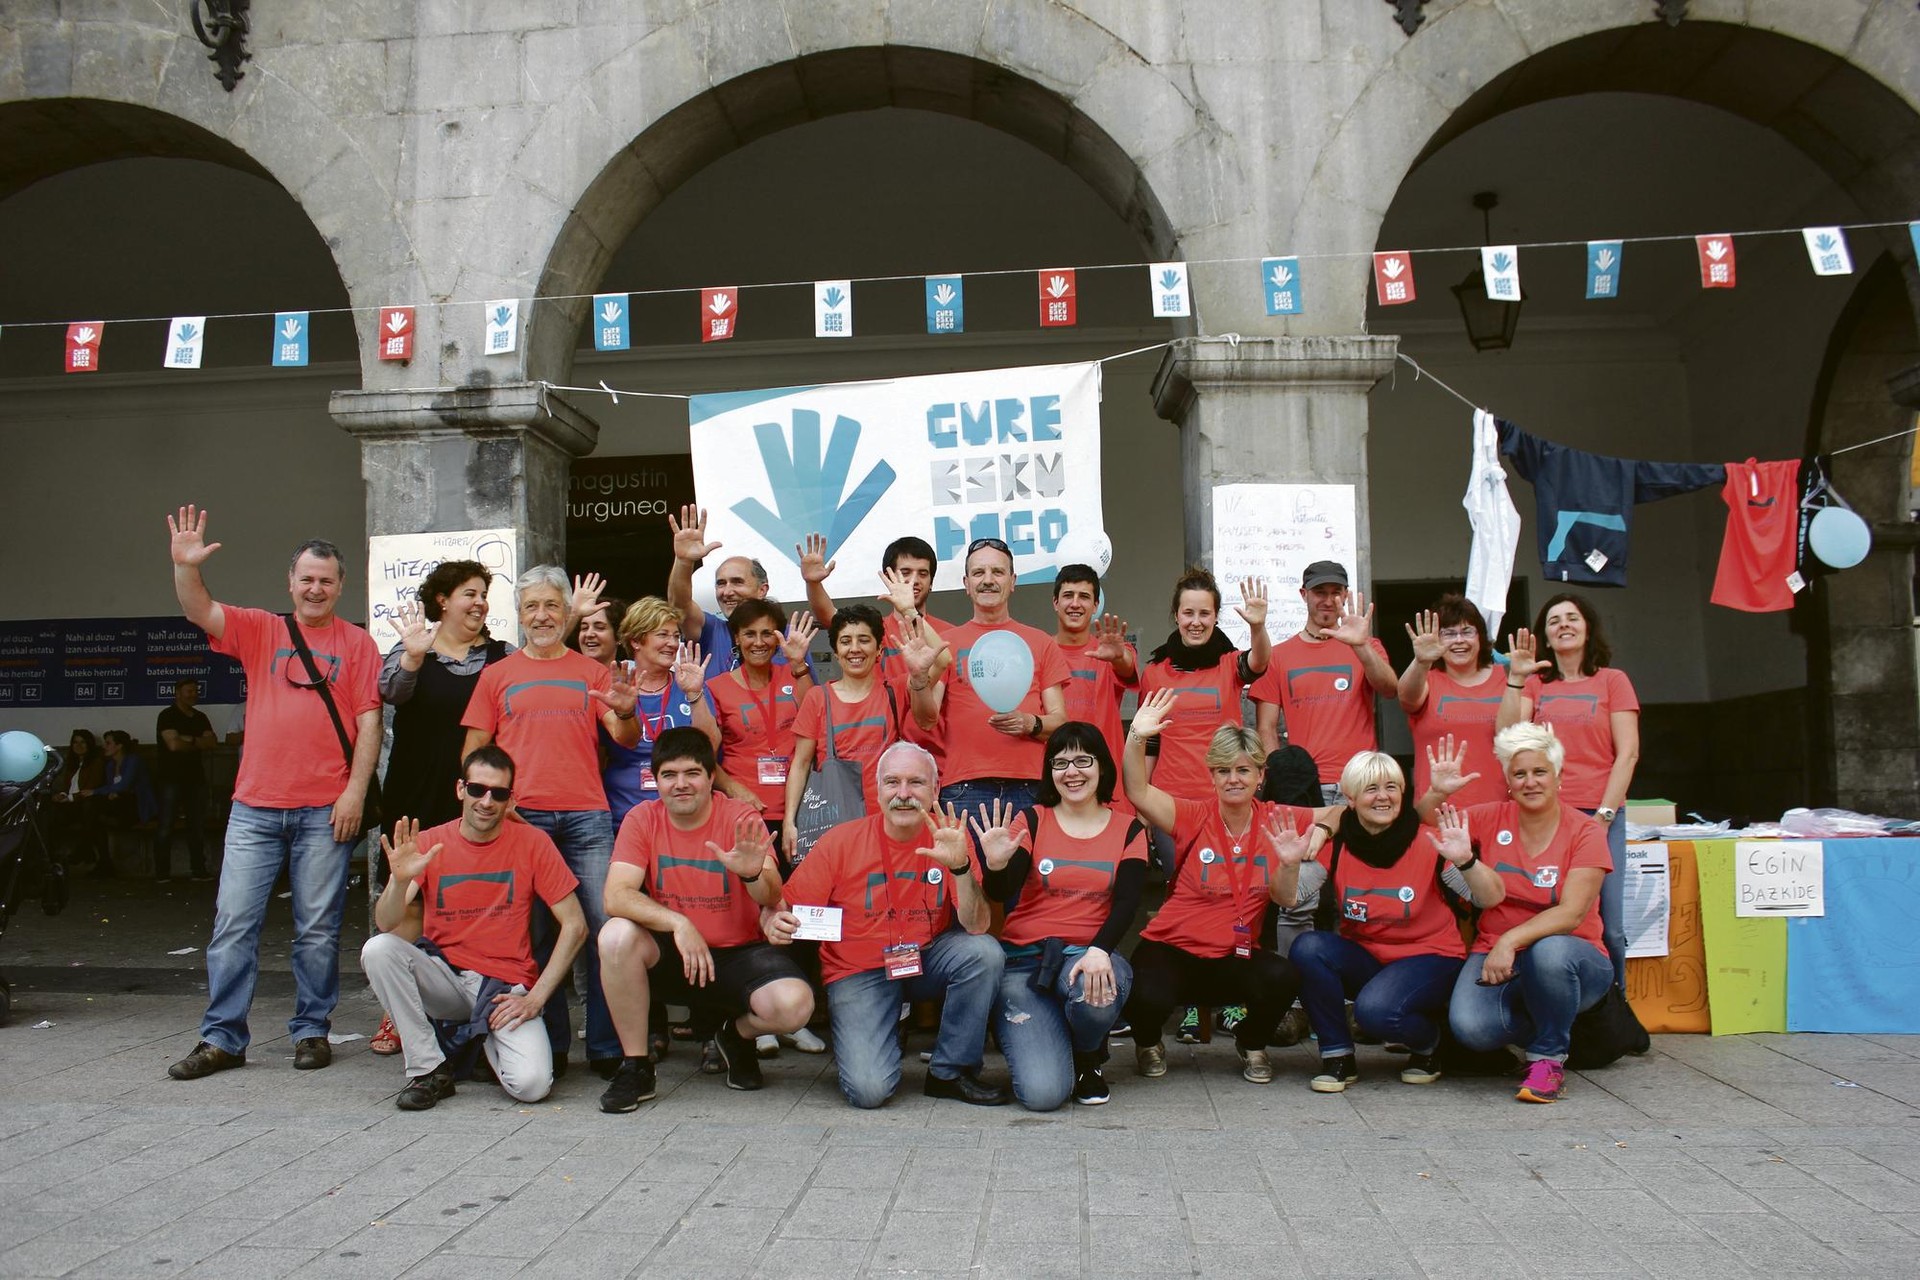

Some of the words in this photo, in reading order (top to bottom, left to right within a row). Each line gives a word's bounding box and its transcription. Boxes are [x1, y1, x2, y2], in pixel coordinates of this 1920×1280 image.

[95, 632, 115, 641] duzu
[177, 630, 199, 640] duzu
[111, 643, 136, 653] estatu
[166, 643, 192, 652] euskal
[65, 669, 92, 678] bateko
[147, 667, 174, 676] bateko
[176, 665, 211, 676] herritar?
[25, 688, 37, 697] EZ
[78, 687, 93, 696] BAI
[108, 687, 119, 695] EZ
[160, 686, 176, 694] BAI
